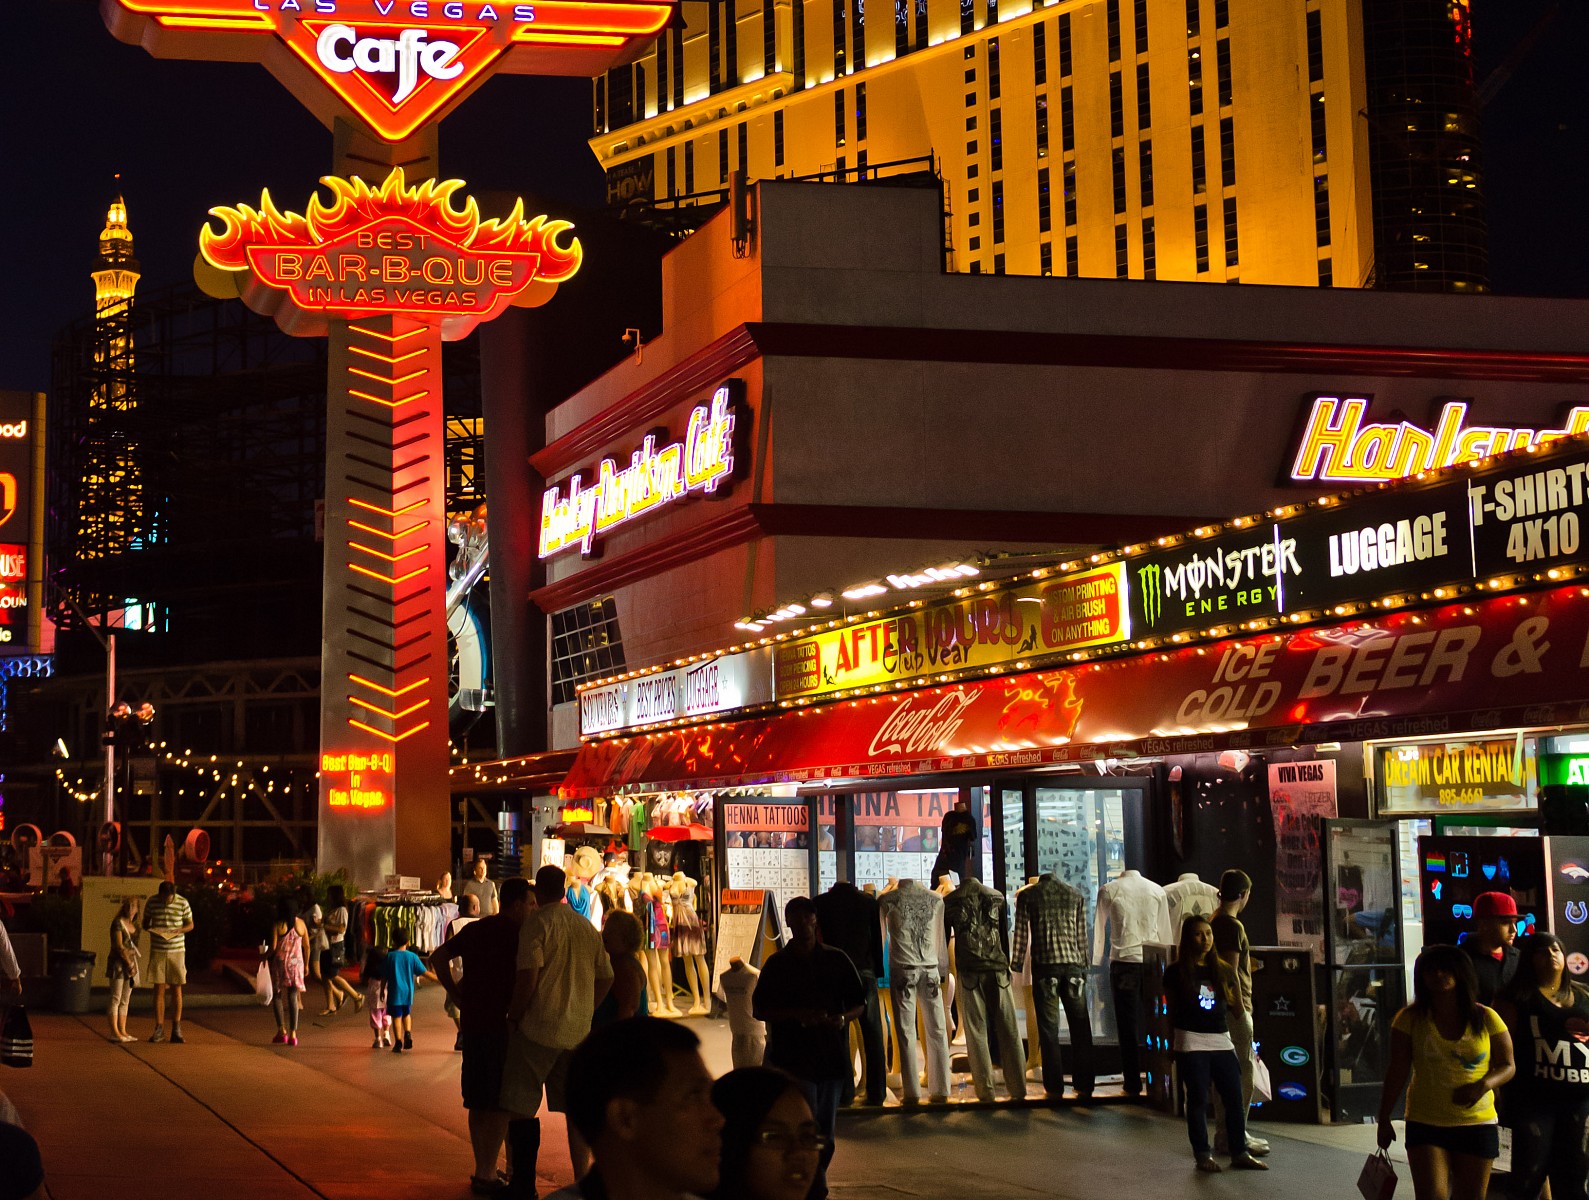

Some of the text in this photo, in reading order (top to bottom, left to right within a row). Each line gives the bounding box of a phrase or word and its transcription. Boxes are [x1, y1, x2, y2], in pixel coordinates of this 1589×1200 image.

[375, 0, 536, 22] VEGAS
[316, 22, 464, 103] Cafe
[356, 232, 431, 251] BEST
[274, 253, 514, 287] BAR-B-QUE
[309, 288, 477, 307] IN LAS VEGAS
[0, 420, 27, 438] od
[1467, 461, 1589, 527] T-SHIRT
[1329, 511, 1448, 578] LUGGAGE
[1506, 512, 1580, 563] 4X10
[1076, 577, 1116, 600] PRINTING
[1186, 584, 1280, 617] ENERGY
[1061, 604, 1075, 622] AIR
[1076, 598, 1106, 620] BRUSH
[836, 615, 917, 677] AFTER
[1051, 617, 1110, 643] ON ANYTHING
[883, 638, 924, 673] Club
[1212, 641, 1284, 684] ICE
[1297, 615, 1552, 700] BEER &
[686, 665, 719, 712] LUGGAGE
[1175, 681, 1282, 724] COLD
[868, 688, 984, 757] Coca-Cola
[1349, 720, 1389, 738] VEGAS
[1391, 715, 1449, 735] refreshed
[987, 751, 1042, 767] VEGAS refreshed
[1141, 739, 1171, 753] VEGAS
[1172, 736, 1214, 751] refreshed
[867, 764, 886, 774] VEGAS
[1278, 764, 1324, 783] VIVA VEGAS
[1385, 750, 1431, 787] DREAM
[1433, 747, 1461, 785] CAR
[727, 804, 808, 826] HENNA TATTOOS
